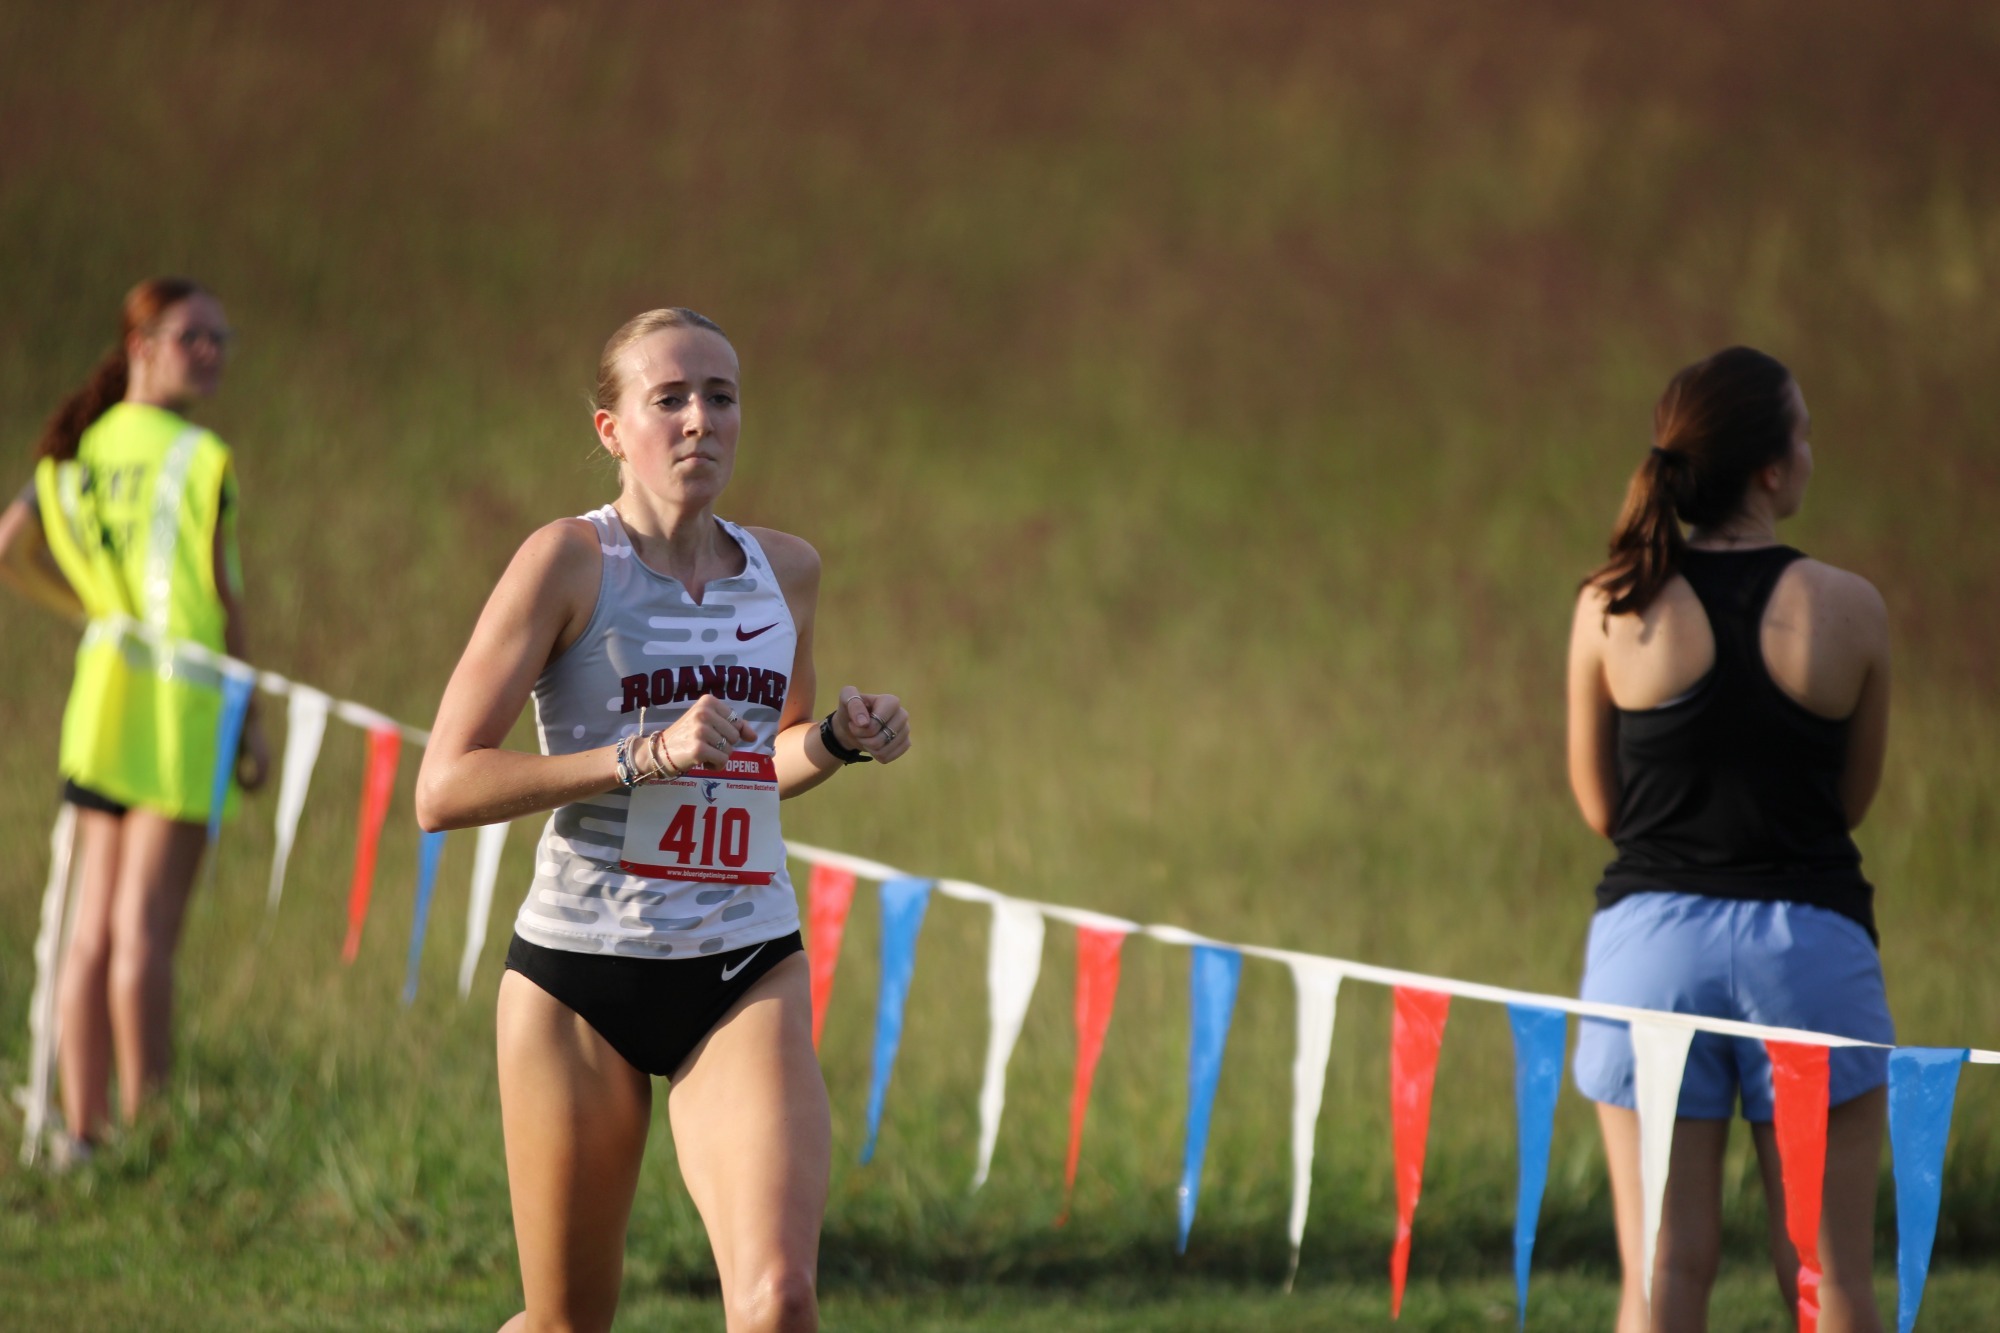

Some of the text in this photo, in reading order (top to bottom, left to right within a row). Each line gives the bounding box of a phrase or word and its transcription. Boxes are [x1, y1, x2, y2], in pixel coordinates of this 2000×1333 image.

[621, 665, 787, 714] ROANOKE
[725, 760, 760, 774] OPENER
[726, 782, 753, 790] Kernstown
[658, 804, 751, 868] 410
[666, 869, 739, 880] www.blueridgetiming.com
